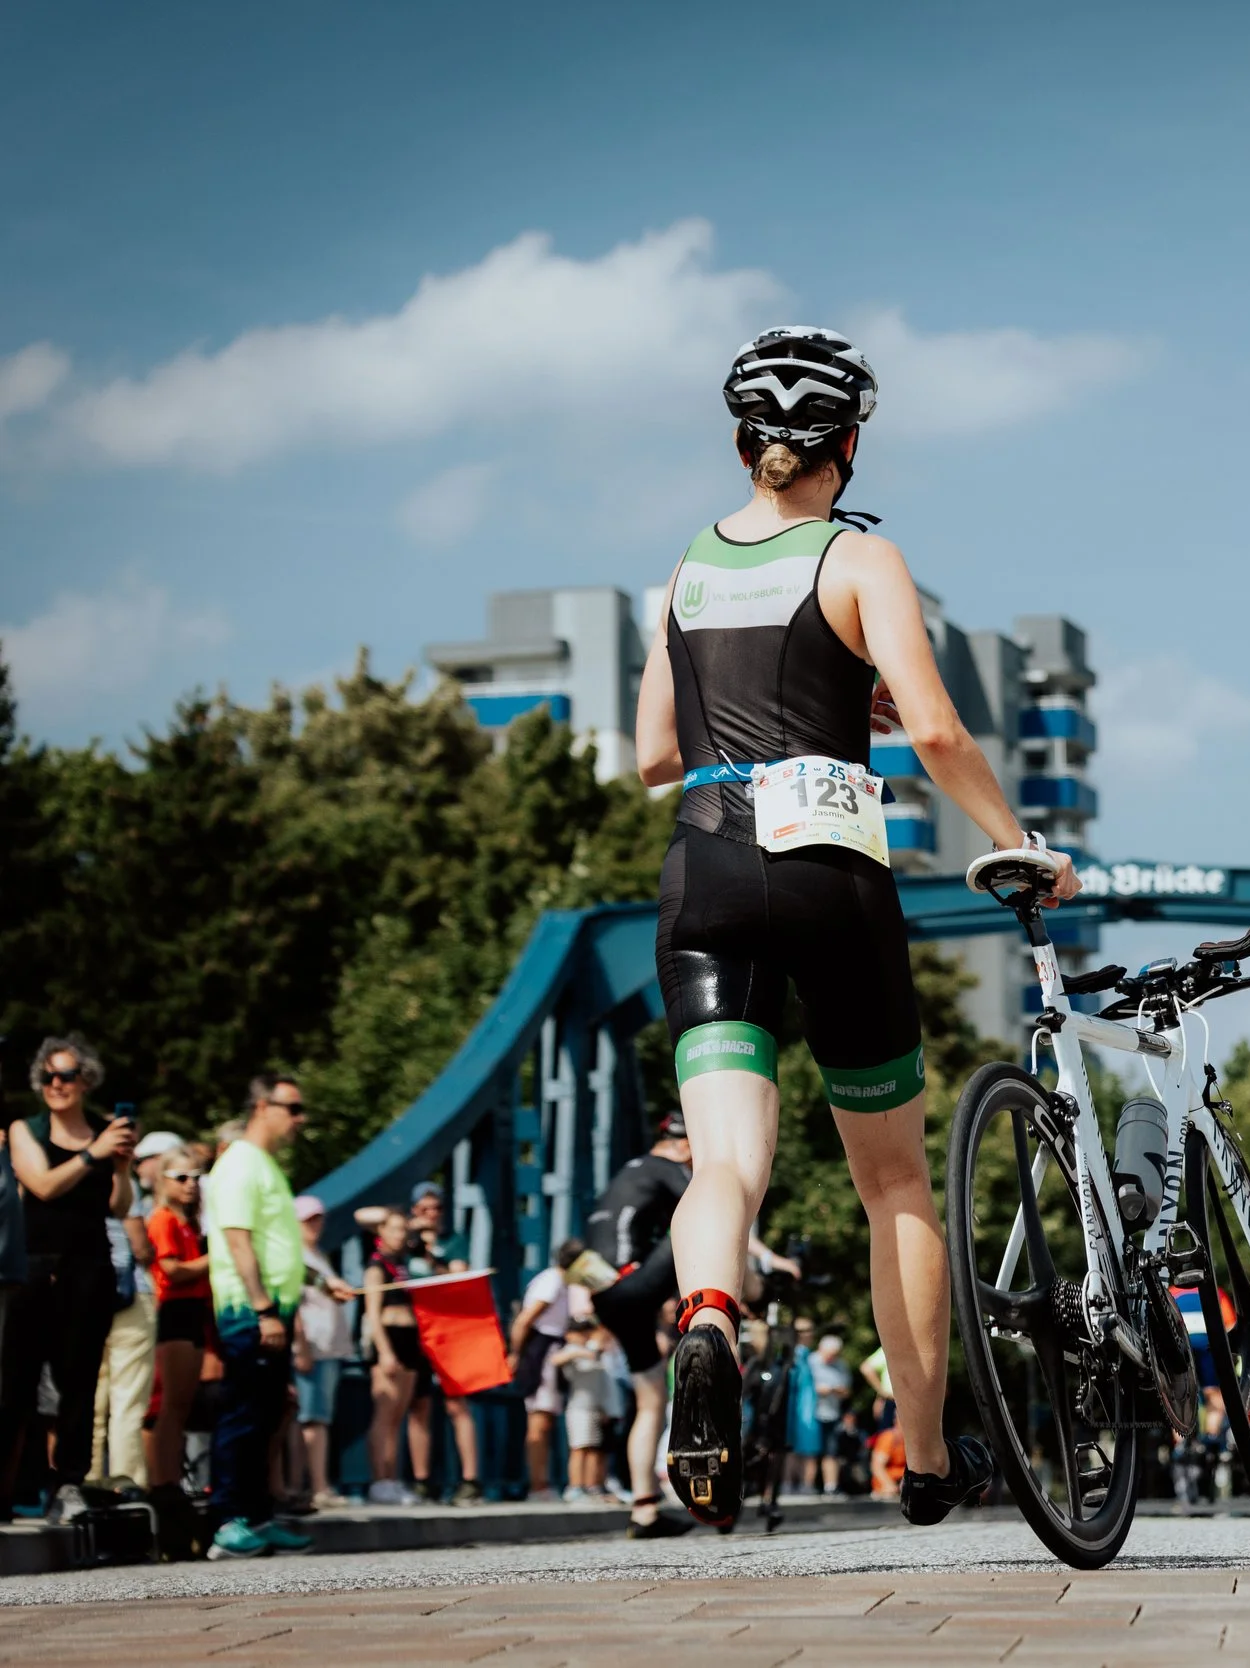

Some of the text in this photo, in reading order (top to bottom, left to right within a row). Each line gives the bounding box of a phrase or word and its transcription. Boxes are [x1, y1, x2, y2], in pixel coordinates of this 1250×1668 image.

[729, 585, 784, 602] WOLFSBURG
[790, 776, 859, 815] 123
[812, 809, 845, 820] Jasmin
[1077, 863, 1226, 896] ch-Brücke
